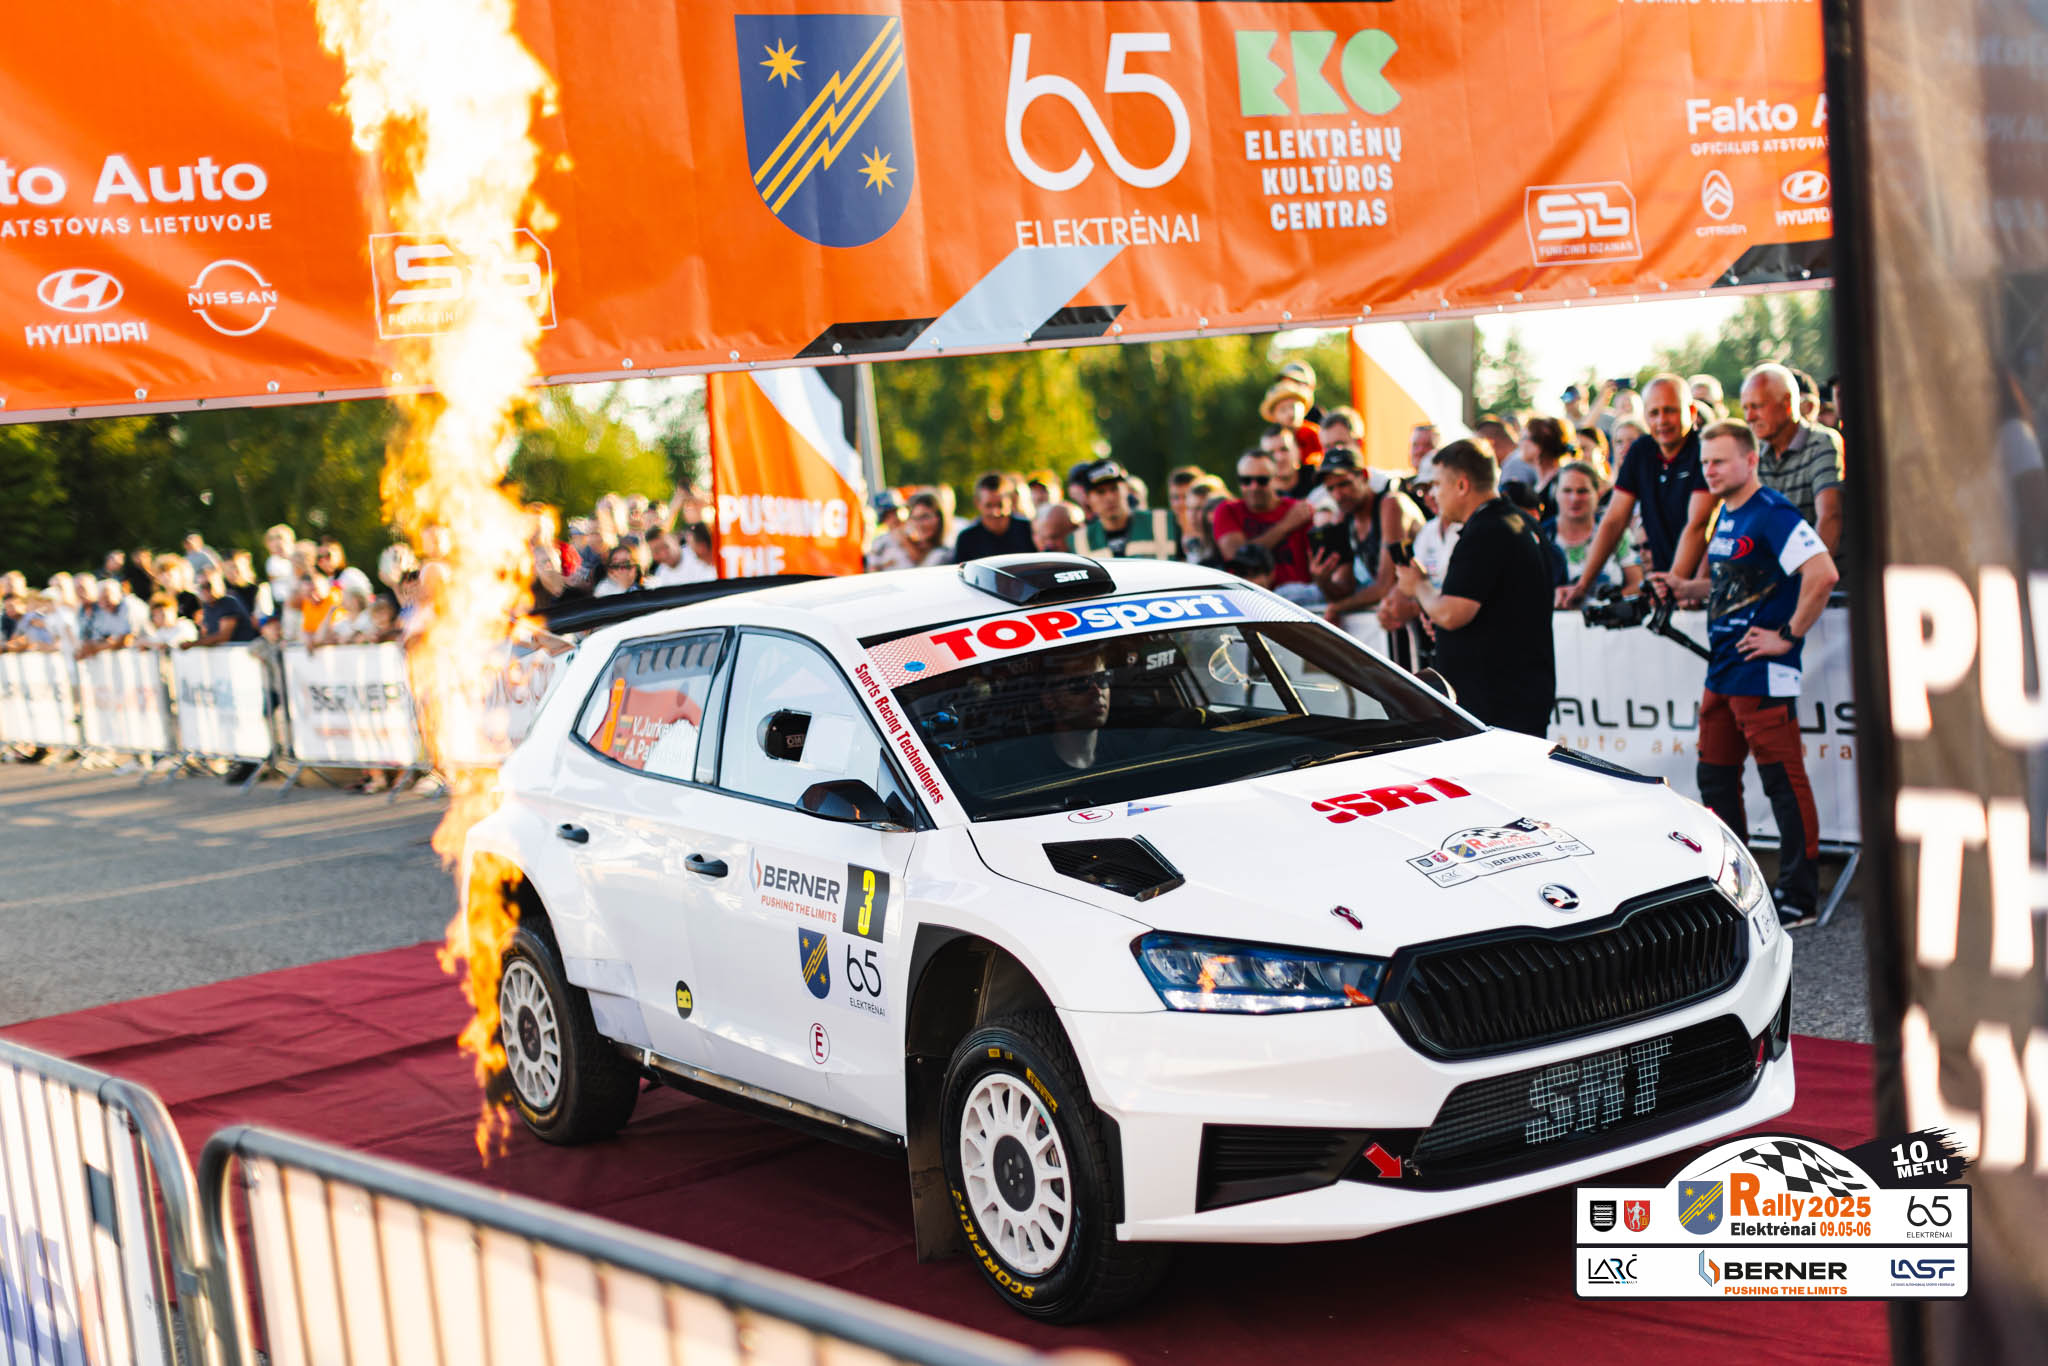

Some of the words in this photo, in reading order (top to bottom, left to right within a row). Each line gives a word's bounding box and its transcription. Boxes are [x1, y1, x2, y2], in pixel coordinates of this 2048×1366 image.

[1005, 32, 1191, 191] 65
[1686, 97, 1798, 135] Fakto
[1245, 121, 1402, 162] ELEKTRĖNŲ
[92, 154, 268, 204] Auto
[1262, 157, 1393, 195] KULTŪROS
[0, 218, 131, 239] ATSTOVAS
[140, 211, 272, 234] LIETUVOJE
[1015, 208, 1200, 250] ELEKTRĖNAI
[1270, 199, 1388, 231] CENTRAS
[1775, 207, 1833, 227] HYUND
[187, 288, 278, 306] NISSAN
[25, 322, 148, 348] HYUNDAI
[717, 494, 848, 537] PUSHING
[1053, 569, 1090, 584] SRT
[1145, 648, 1177, 671] SRT
[854, 662, 881, 698] Sports
[874, 695, 903, 735] Racing
[896, 730, 944, 805] Technologies
[1491, 850, 1544, 867] BERNER
[762, 864, 841, 905] BERNER
[857, 869, 876, 936] 3
[760, 894, 794, 914] PUSHING
[795, 902, 810, 917] THE
[810, 907, 838, 924] LIMITS
[846, 944, 882, 998] 65
[848, 997, 886, 1018] ELEKTRĖNAI
[1524, 1035, 1674, 1145] SRT
